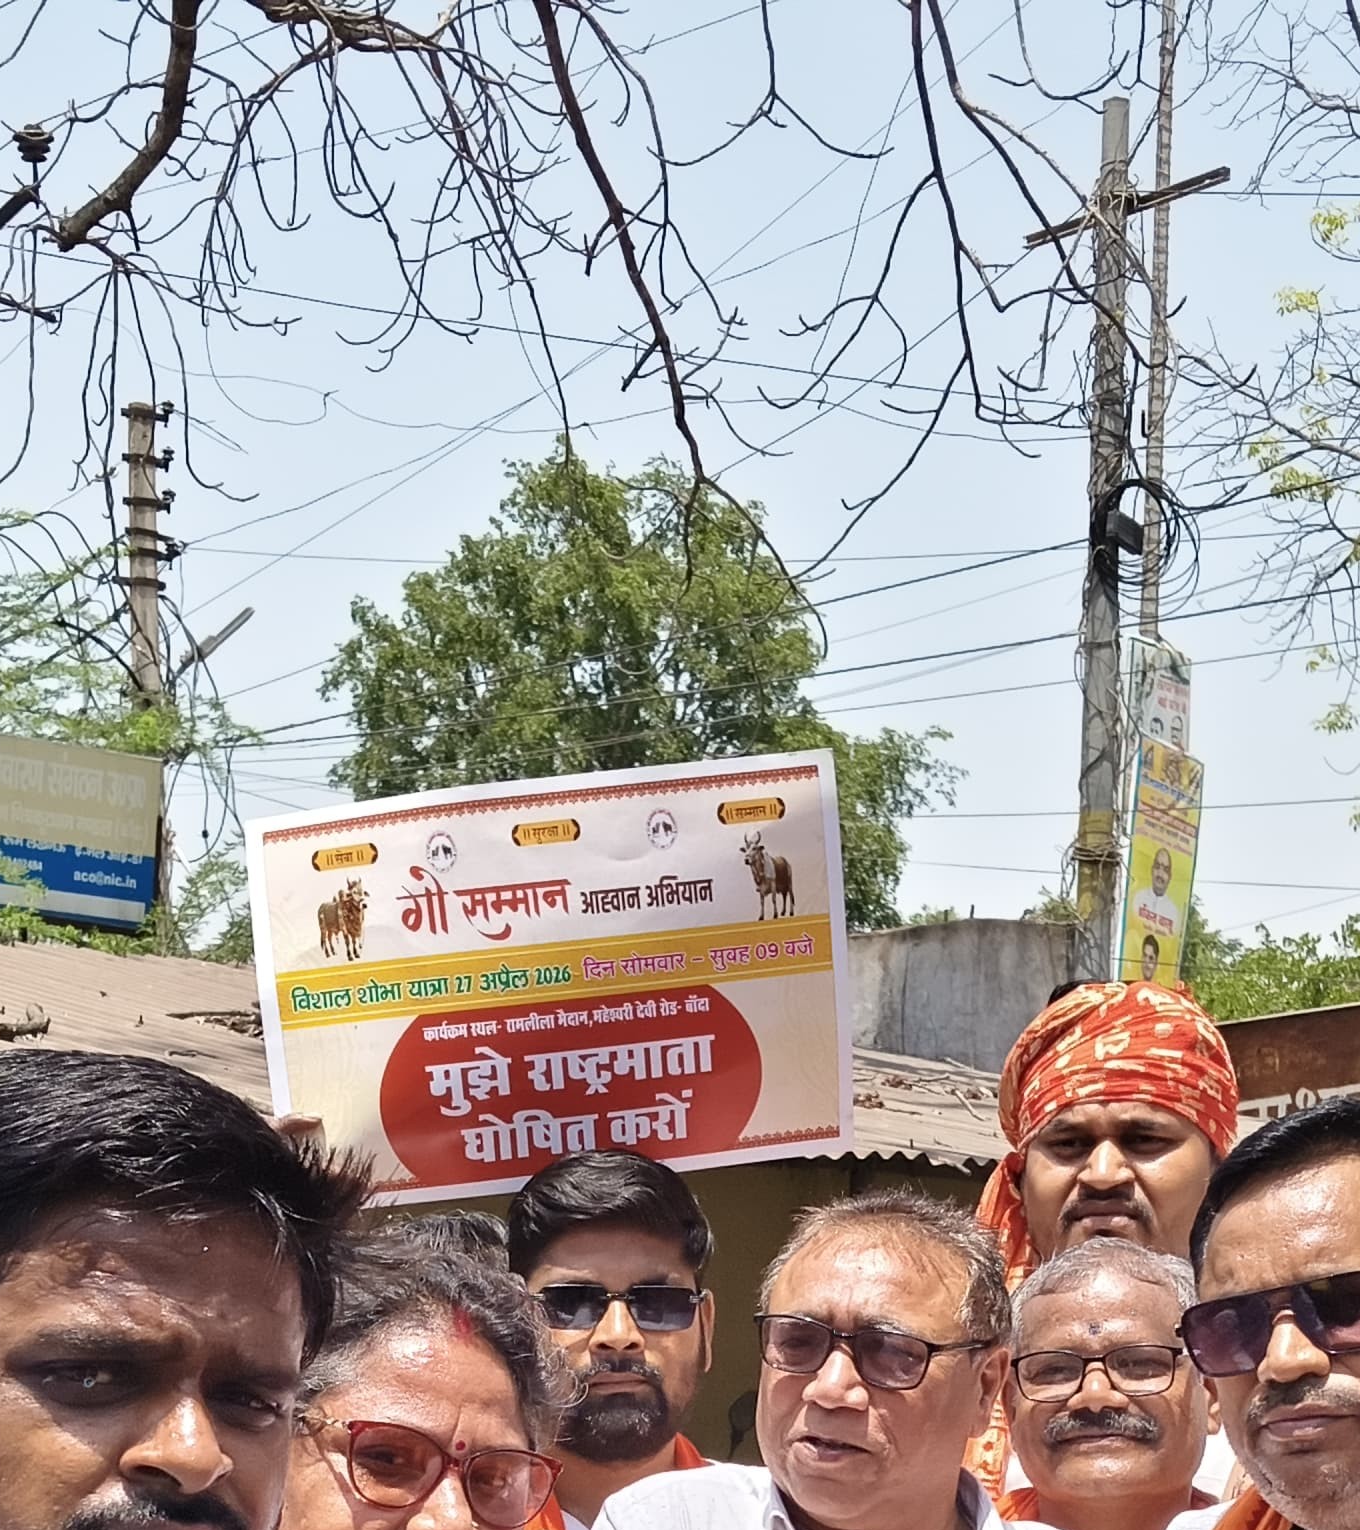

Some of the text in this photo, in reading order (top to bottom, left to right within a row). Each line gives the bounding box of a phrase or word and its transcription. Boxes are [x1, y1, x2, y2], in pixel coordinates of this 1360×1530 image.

[531, 825, 559, 845] सुरक्षा
[735, 805, 767, 820] सम्मान
[335, 850, 353, 864] सेवा
[453, 878, 572, 941] सम्मान
[646, 875, 713, 908] अभियान
[291, 985, 351, 1013] विशाल
[357, 978, 403, 1005] शोभा
[407, 976, 449, 999] यात्रा
[455, 976, 472, 994] 27
[479, 963, 530, 992] अप्रैल
[535, 964, 572, 986] 2026
[583, 956, 615, 980] दिन
[621, 952, 686, 977] सोमवार
[755, 942, 780, 961] 09
[506, 1012, 555, 1034] रामलीला
[636, 1000, 657, 1020] देवी
[424, 1034, 716, 1117] मुझे राष्ट्रमाता
[461, 1088, 693, 1163] घोषित करों
